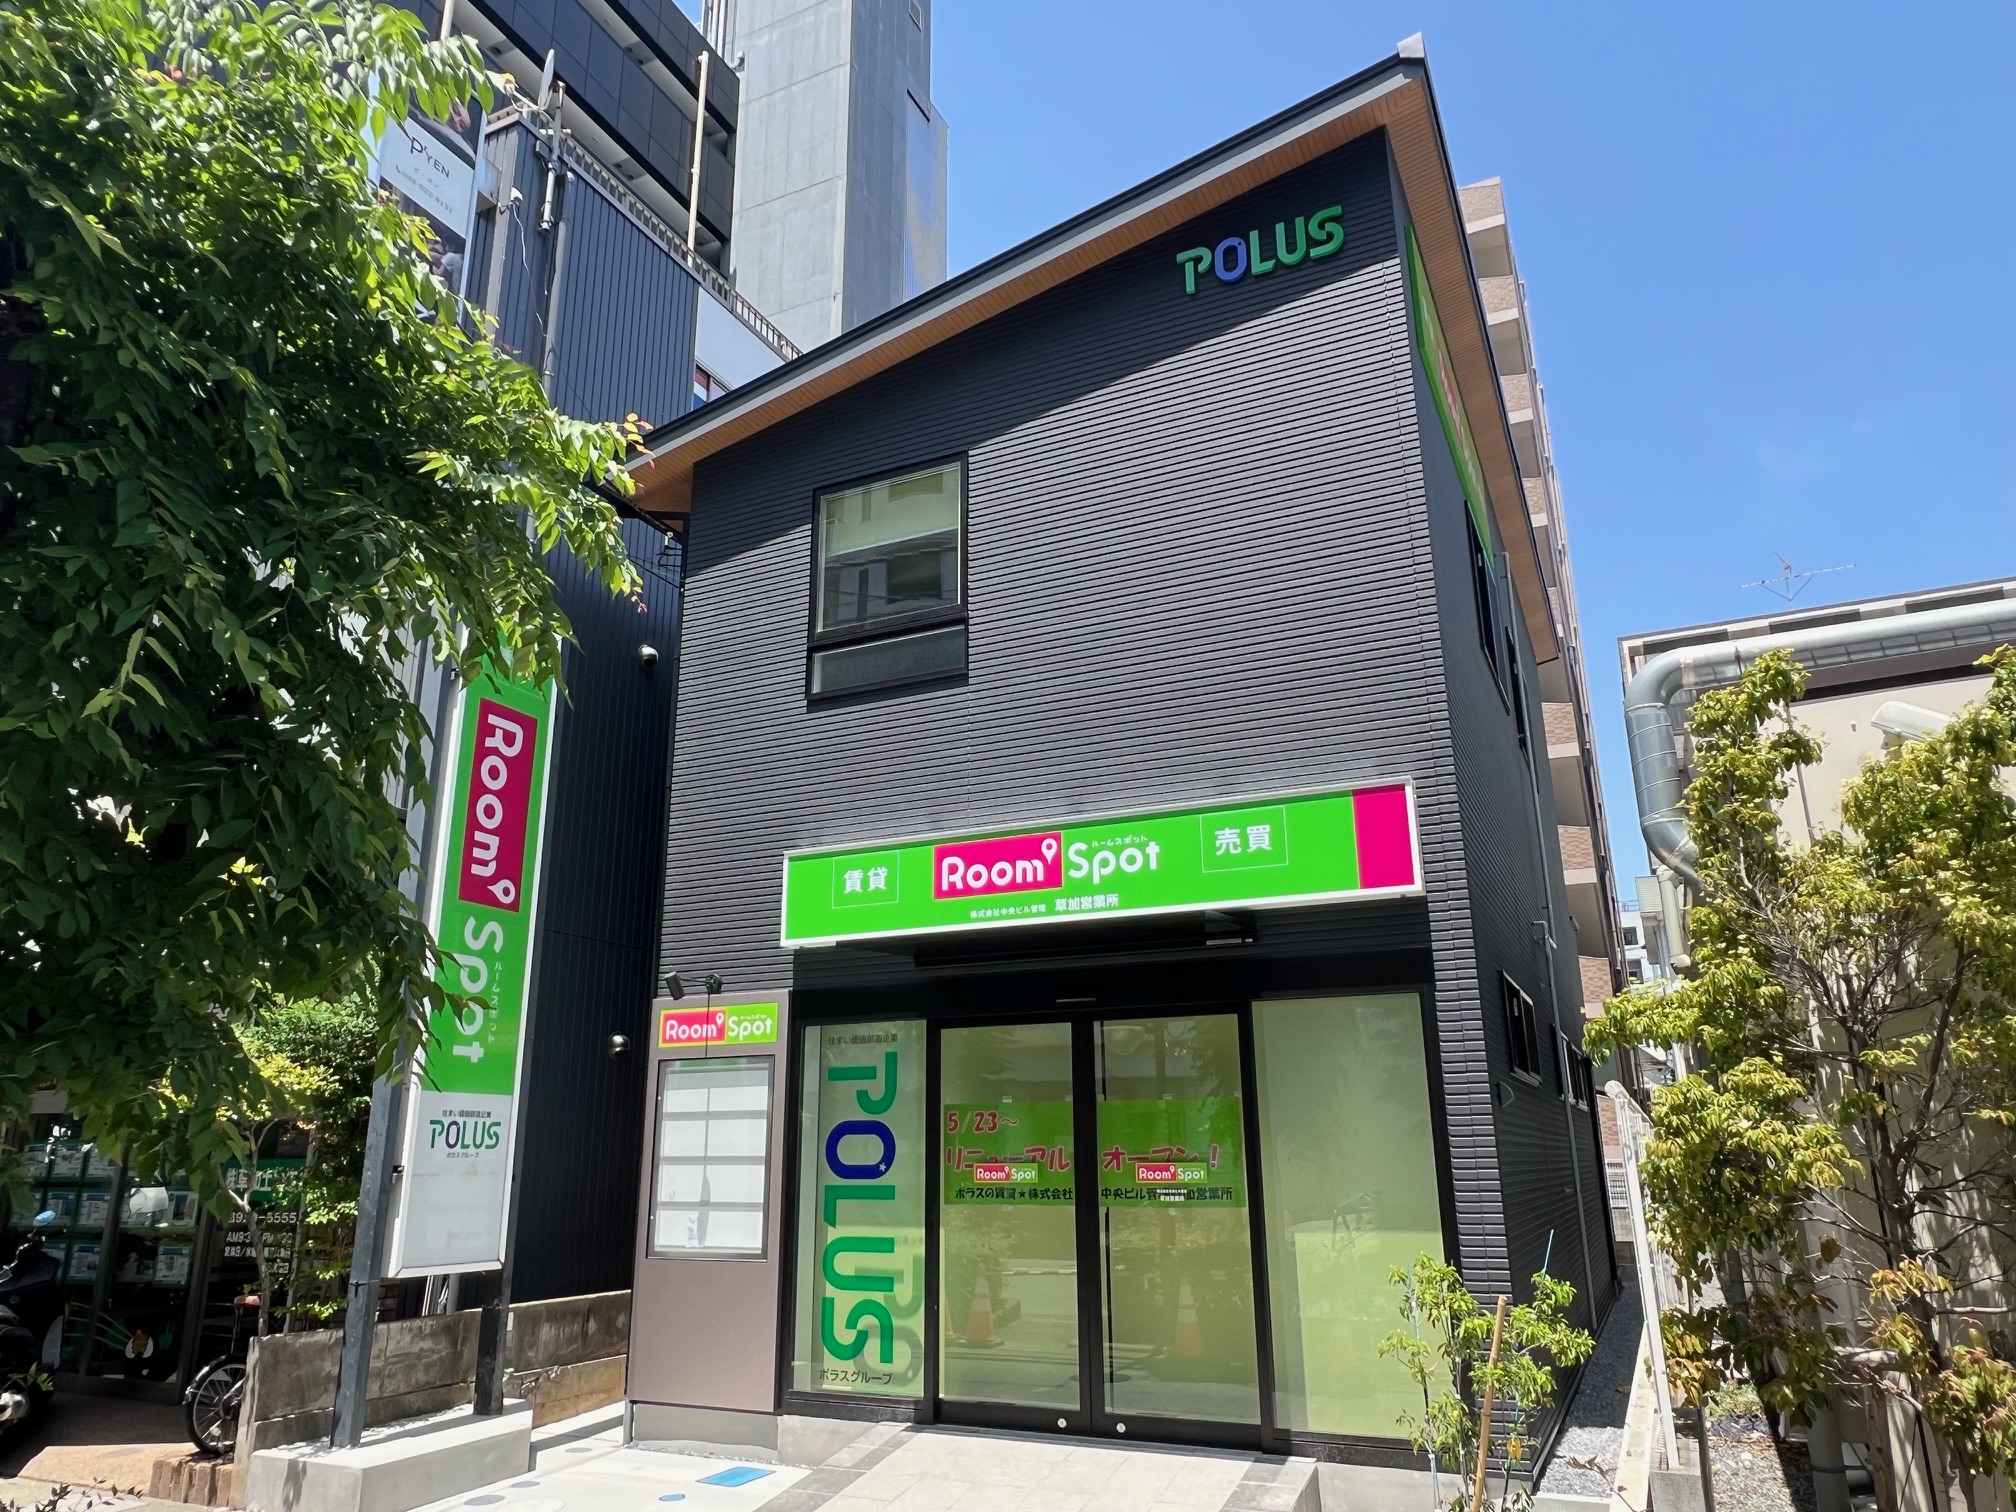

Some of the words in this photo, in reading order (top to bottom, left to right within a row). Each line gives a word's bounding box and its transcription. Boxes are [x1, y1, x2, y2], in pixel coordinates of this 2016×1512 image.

[1176, 205, 1344, 294] POLUS
[471, 713, 524, 877] Room
[1091, 834, 1148, 848] ルームスポット
[1214, 824, 1273, 856] 売買
[843, 866, 888, 894] 賃貸
[941, 855, 1045, 891] Room
[1068, 841, 1160, 885] Spot
[1054, 893, 1120, 913] 草加営業所
[452, 915, 504, 1063] Spot
[665, 1019, 717, 1041] Room
[727, 1015, 773, 1042] Spot
[429, 1119, 502, 1150] POLUS
[976, 1168, 1007, 1180] Room
[1011, 1168, 1036, 1182] Spot
[1138, 1167, 1172, 1180] Room
[1177, 1168, 1206, 1182] Spot
[820, 1051, 898, 1364] POLUS
[819, 1367, 893, 1385] ポラスグループ
